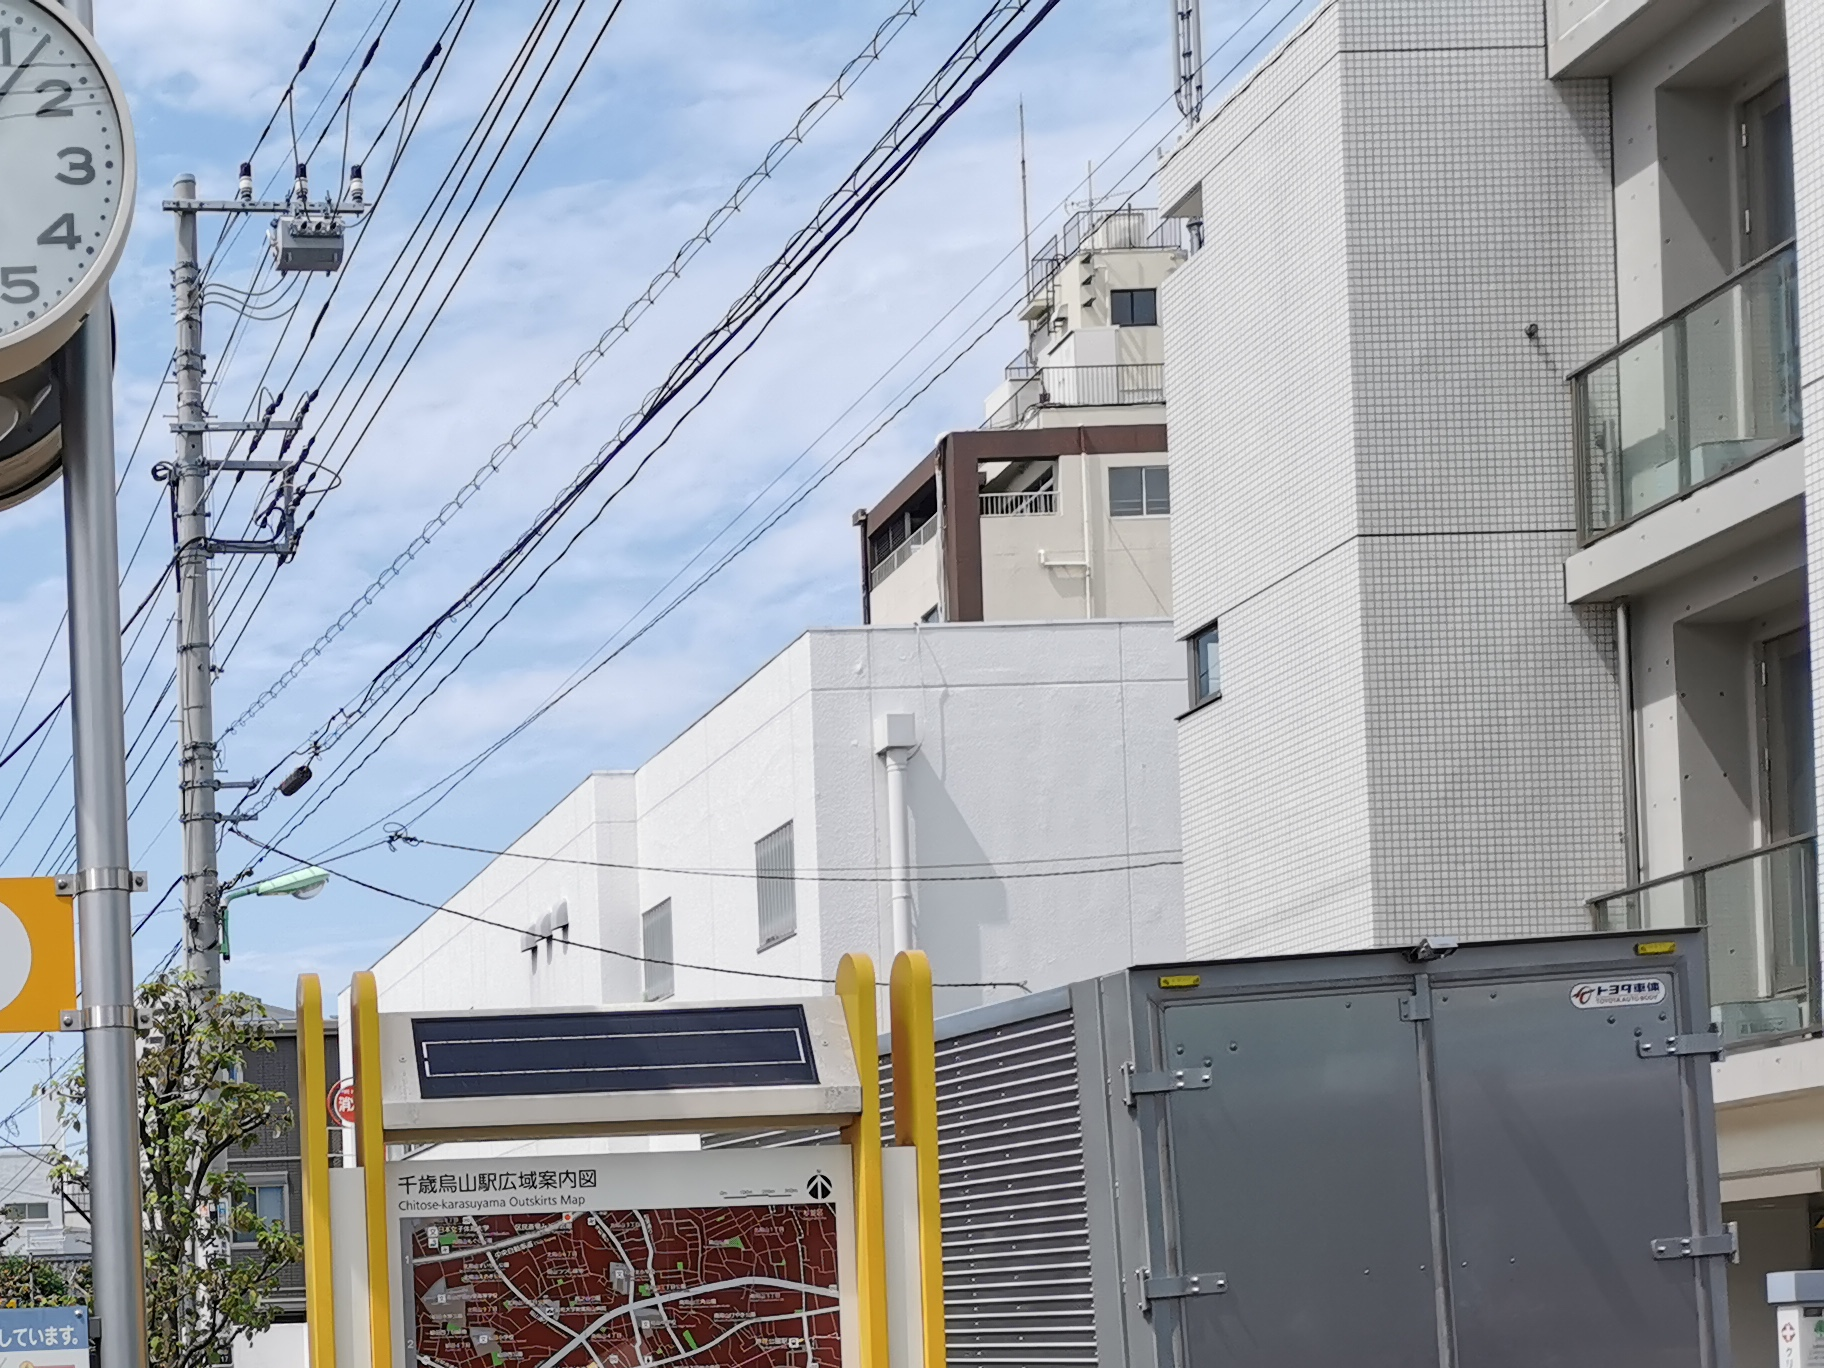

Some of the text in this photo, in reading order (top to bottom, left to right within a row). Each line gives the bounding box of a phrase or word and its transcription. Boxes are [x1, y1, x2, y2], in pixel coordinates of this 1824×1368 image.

[35, 80, 73, 117] 2
[55, 147, 96, 185] 3
[37, 213, 82, 250] 4
[0, 266, 40, 304] 5
[1597, 982, 1660, 995] トヨタ車体
[398, 1170, 597, 1194] 千歳烏山駅広域案内図
[398, 1195, 585, 1211] Chitose-karasuyama Outskirts Map
